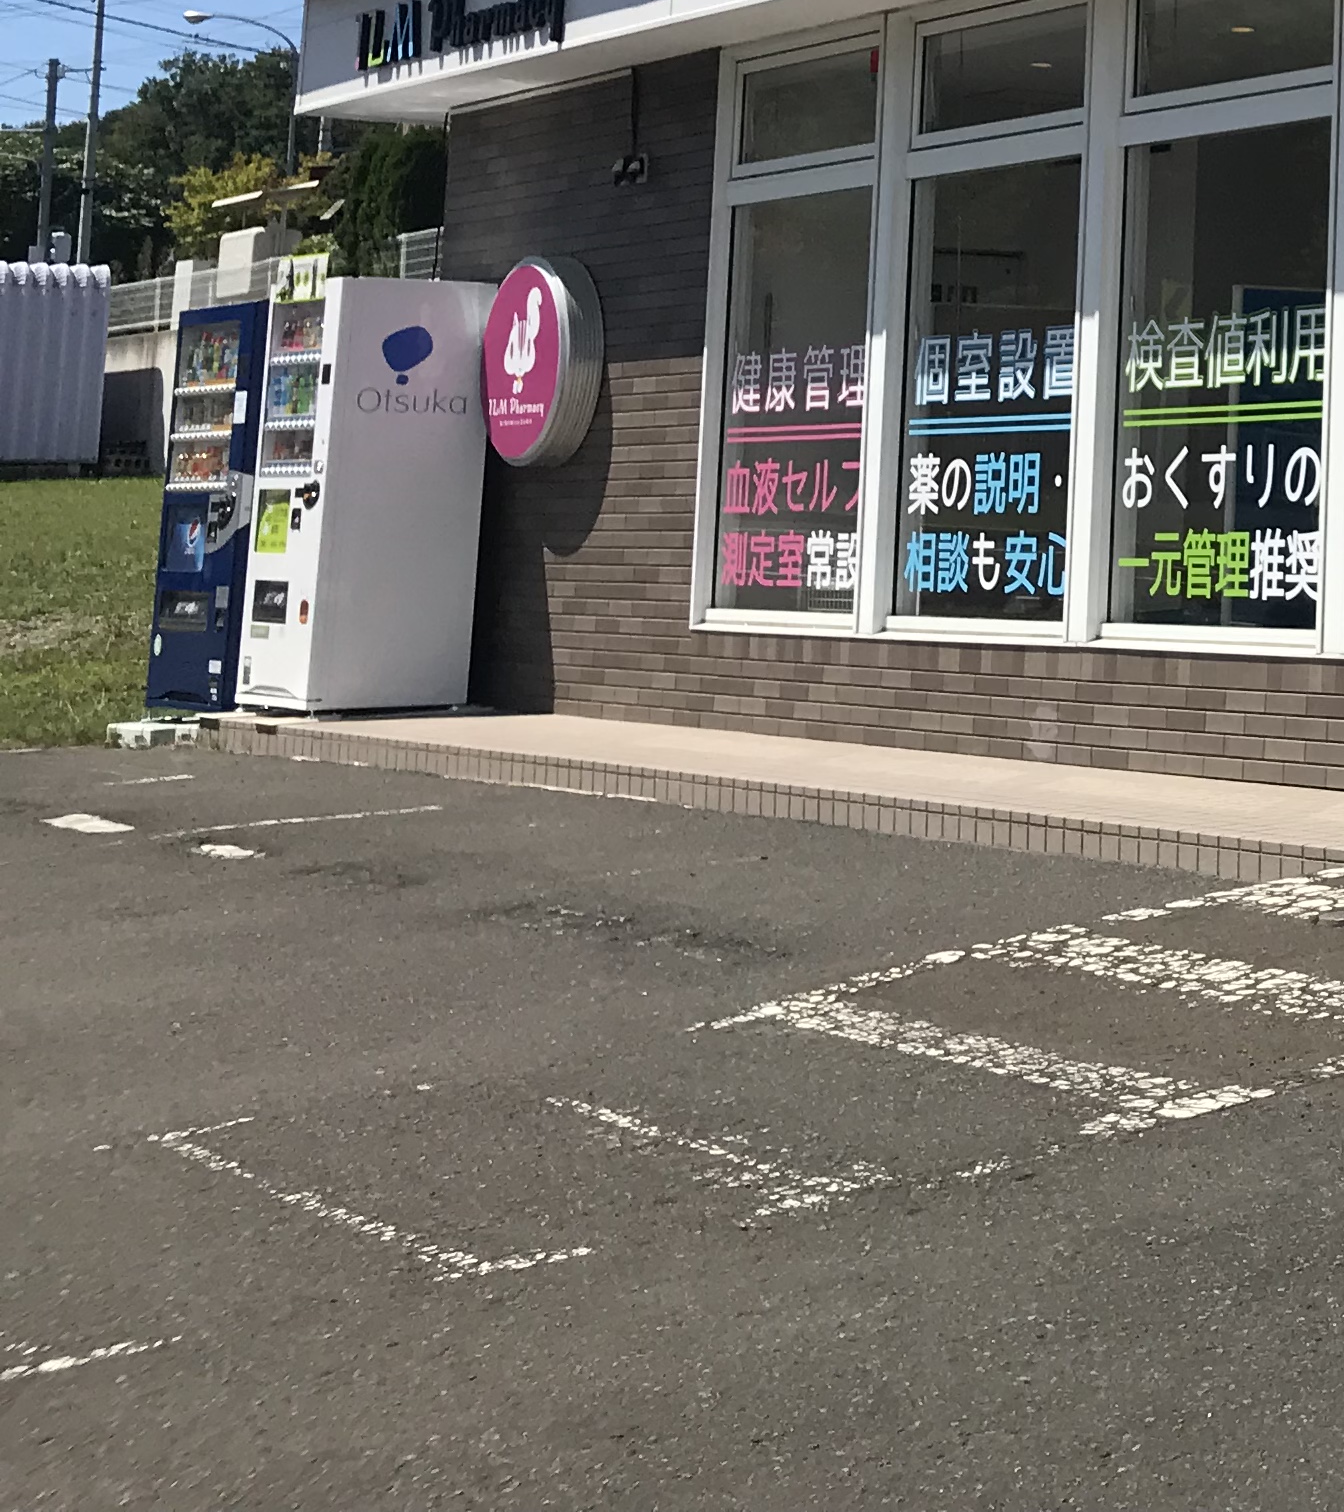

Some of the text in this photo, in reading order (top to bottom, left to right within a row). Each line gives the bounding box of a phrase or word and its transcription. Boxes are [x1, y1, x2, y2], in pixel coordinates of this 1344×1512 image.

[730, 345, 866, 415] 健康管理
[914, 325, 1076, 406] 個室設置
[1125, 305, 1326, 394] 検査値利用
[357, 387, 468, 414] Otsuka
[1121, 443, 1321, 510] おくすりの
[721, 528, 858, 590] 測定室常設
[903, 529, 1067, 596] 相談も安心
[1118, 526, 1321, 601] 一元管理推奨
